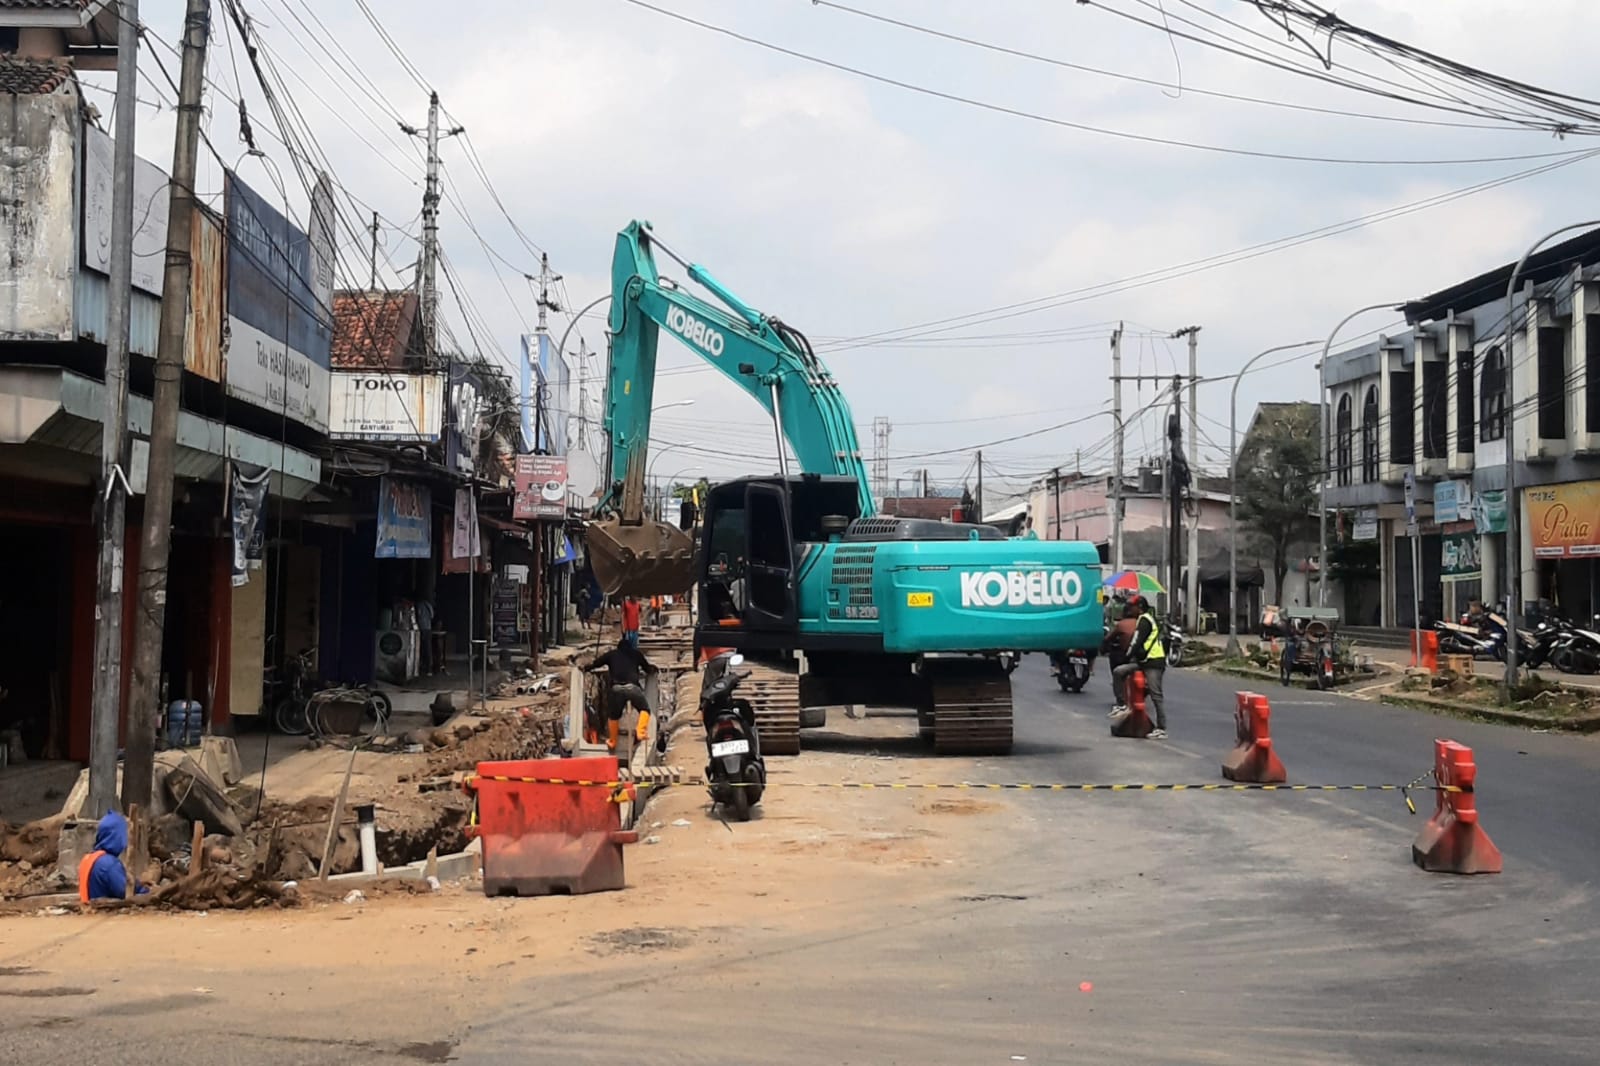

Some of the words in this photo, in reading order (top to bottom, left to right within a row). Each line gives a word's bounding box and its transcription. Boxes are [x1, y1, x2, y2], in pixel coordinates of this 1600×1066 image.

[665, 303, 724, 356] KOBELCO
[352, 379, 407, 391] TOKO
[960, 571, 1082, 607] KOBELCO
